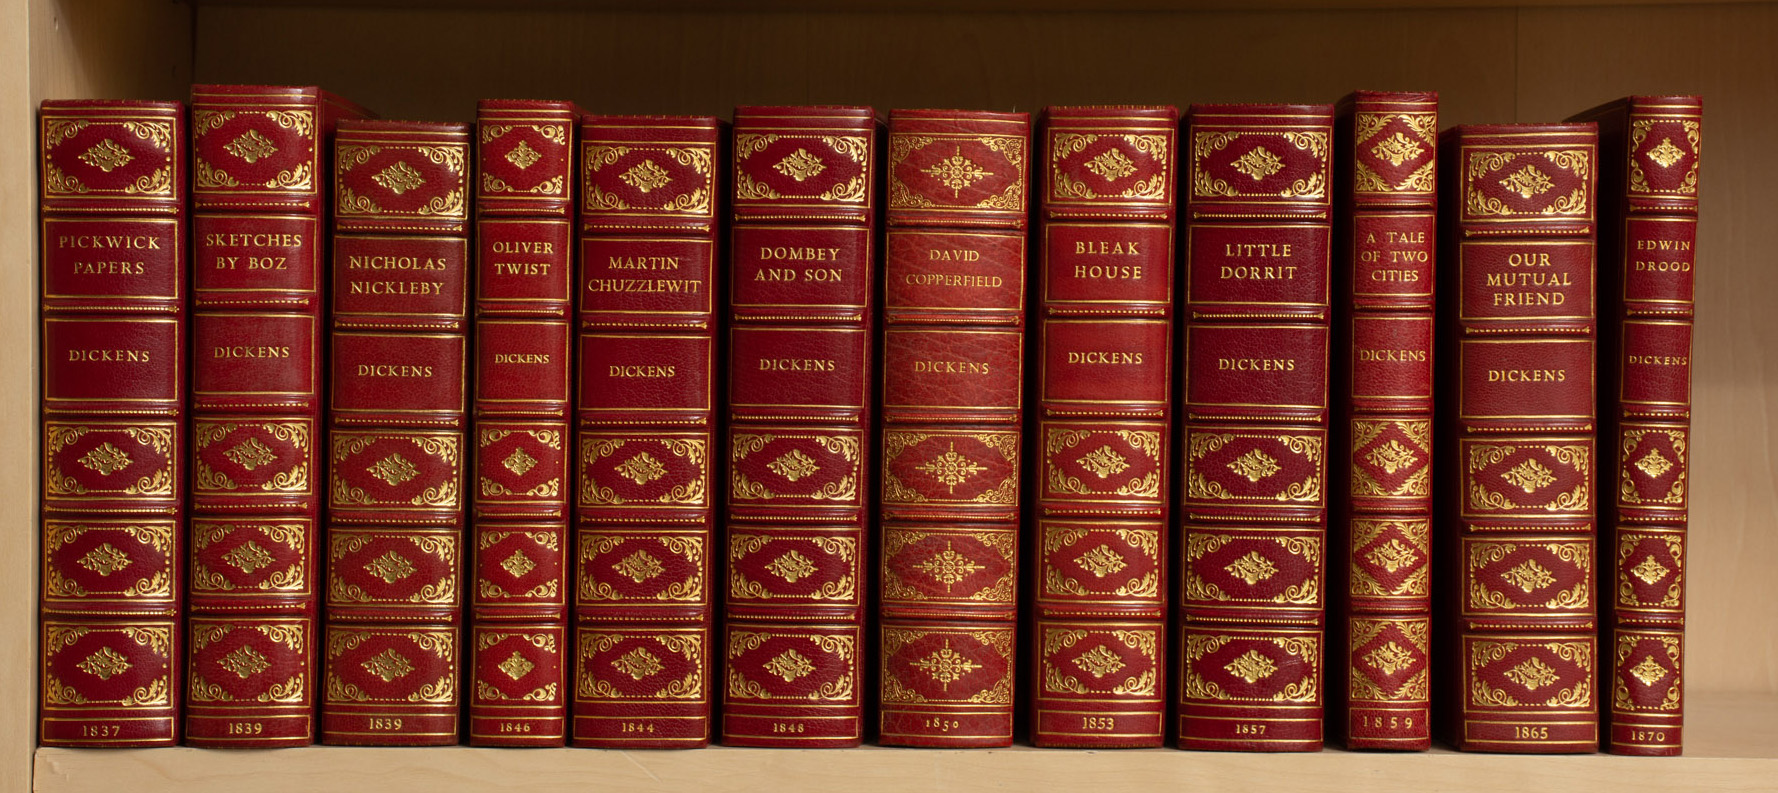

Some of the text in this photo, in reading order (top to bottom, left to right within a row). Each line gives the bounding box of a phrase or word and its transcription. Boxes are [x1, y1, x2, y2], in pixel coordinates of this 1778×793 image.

[60, 236, 160, 249] PICKWICK
[207, 234, 301, 248] SKETCHES
[1367, 232, 1424, 244] A TALE
[493, 242, 553, 254] OLIVER
[1076, 242, 1139, 255] BLEAK
[1226, 244, 1291, 257] LITTLE
[1638, 240, 1690, 250] EDWIN
[761, 247, 840, 261] DOMBEY
[930, 250, 979, 261] DAVID
[1361, 251, 1428, 262] OF TWO
[1509, 254, 1551, 266] OUR
[74, 262, 144, 274] PAPERS
[217, 257, 286, 269] BY BOZ
[350, 256, 446, 270] NICHOLAS
[495, 263, 550, 275] TWIST
[609, 257, 679, 270] MARTIN
[1636, 261, 1690, 271] DROOD
[754, 269, 842, 282] AND SON
[1075, 266, 1141, 279] HOUSE
[1221, 266, 1297, 279] DORRIT
[1372, 270, 1418, 282] CITIES
[906, 274, 1002, 287] COPPERFIELD
[1487, 273, 1571, 286] MUTUAL
[351, 282, 444, 294] NICKLEBY
[588, 279, 701, 293] CHUZZLEWIT
[1494, 293, 1564, 306] FRIEND
[69, 350, 149, 362] DICKENS
[215, 347, 289, 358] DICKENS
[1069, 352, 1142, 364] DICKENS
[1361, 350, 1425, 363] DICKENS
[495, 354, 549, 364] DICKENS
[760, 359, 834, 371] DICKENS
[1219, 359, 1294, 370] DICKENS
[1630, 356, 1686, 365] DICKENS
[358, 365, 432, 377] DICKENS
[610, 366, 675, 377] DICKENS
[915, 361, 988, 374] DICKENS
[1489, 370, 1565, 382] DICKENS
[229, 723, 262, 734] 1839
[369, 717, 403, 730] 1839
[500, 722, 531, 733] 1846
[622, 723, 654, 732] 1844
[774, 723, 804, 733] 1848
[926, 718, 958, 731] 1850
[1082, 716, 1115, 731] 1853
[1364, 716, 1412, 729] 1859
[83, 725, 120, 736] 1837
[1236, 724, 1265, 734] 1857
[1514, 726, 1549, 740] 1865
[1631, 731, 1666, 743] 1870
